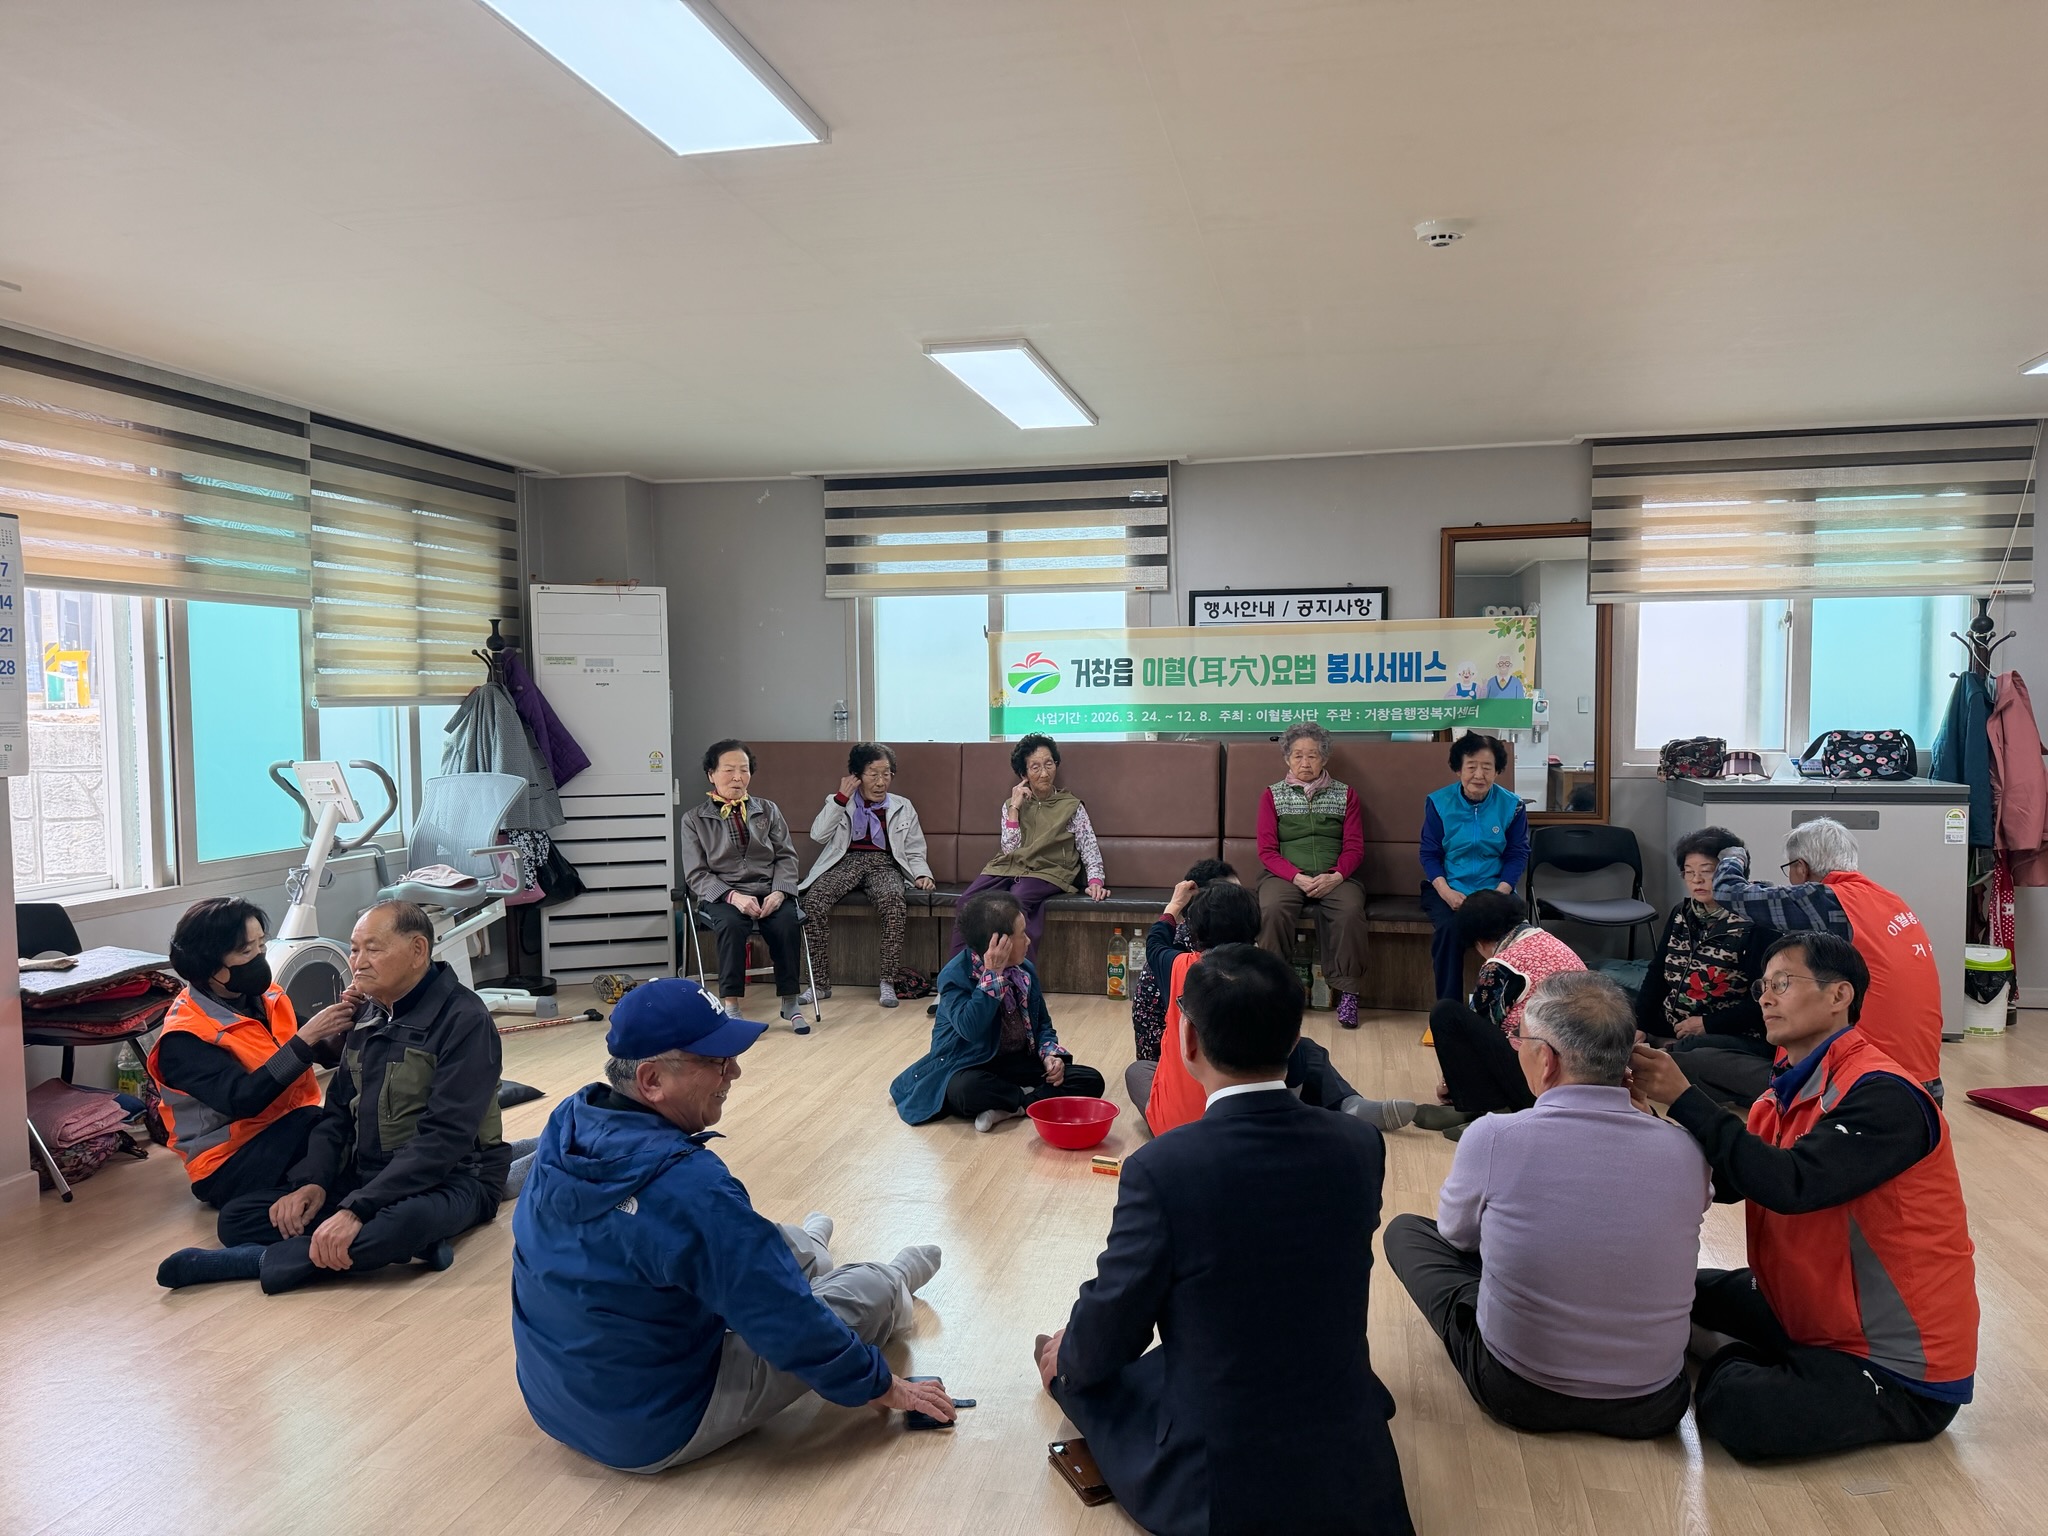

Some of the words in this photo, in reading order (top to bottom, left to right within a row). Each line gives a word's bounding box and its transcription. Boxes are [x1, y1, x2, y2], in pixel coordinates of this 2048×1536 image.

[1203, 600, 1275, 619] 행사안내
[1282, 600, 1289, 617] /
[1296, 597, 1373, 617] 공지사항
[1070, 657, 1134, 688] 거창읍
[1142, 654, 1316, 688] 이혈(耳穴)요법
[1327, 650, 1447, 684] 봉사서비스
[1034, 711, 1081, 726] 사업기간
[1091, 712, 1123, 723] 2026.
[1126, 711, 1137, 722] 3.
[1141, 711, 1161, 722] 24.
[1177, 711, 1196, 722] 12.
[1199, 711, 1212, 722] 8.
[1218, 709, 1244, 722] 주최
[1256, 708, 1319, 722] 이혈봉사단
[1326, 708, 1352, 722] 주관
[1364, 705, 1480, 721] 거창읍행정복지센터
[1887, 911, 1919, 936] 이혈봉
